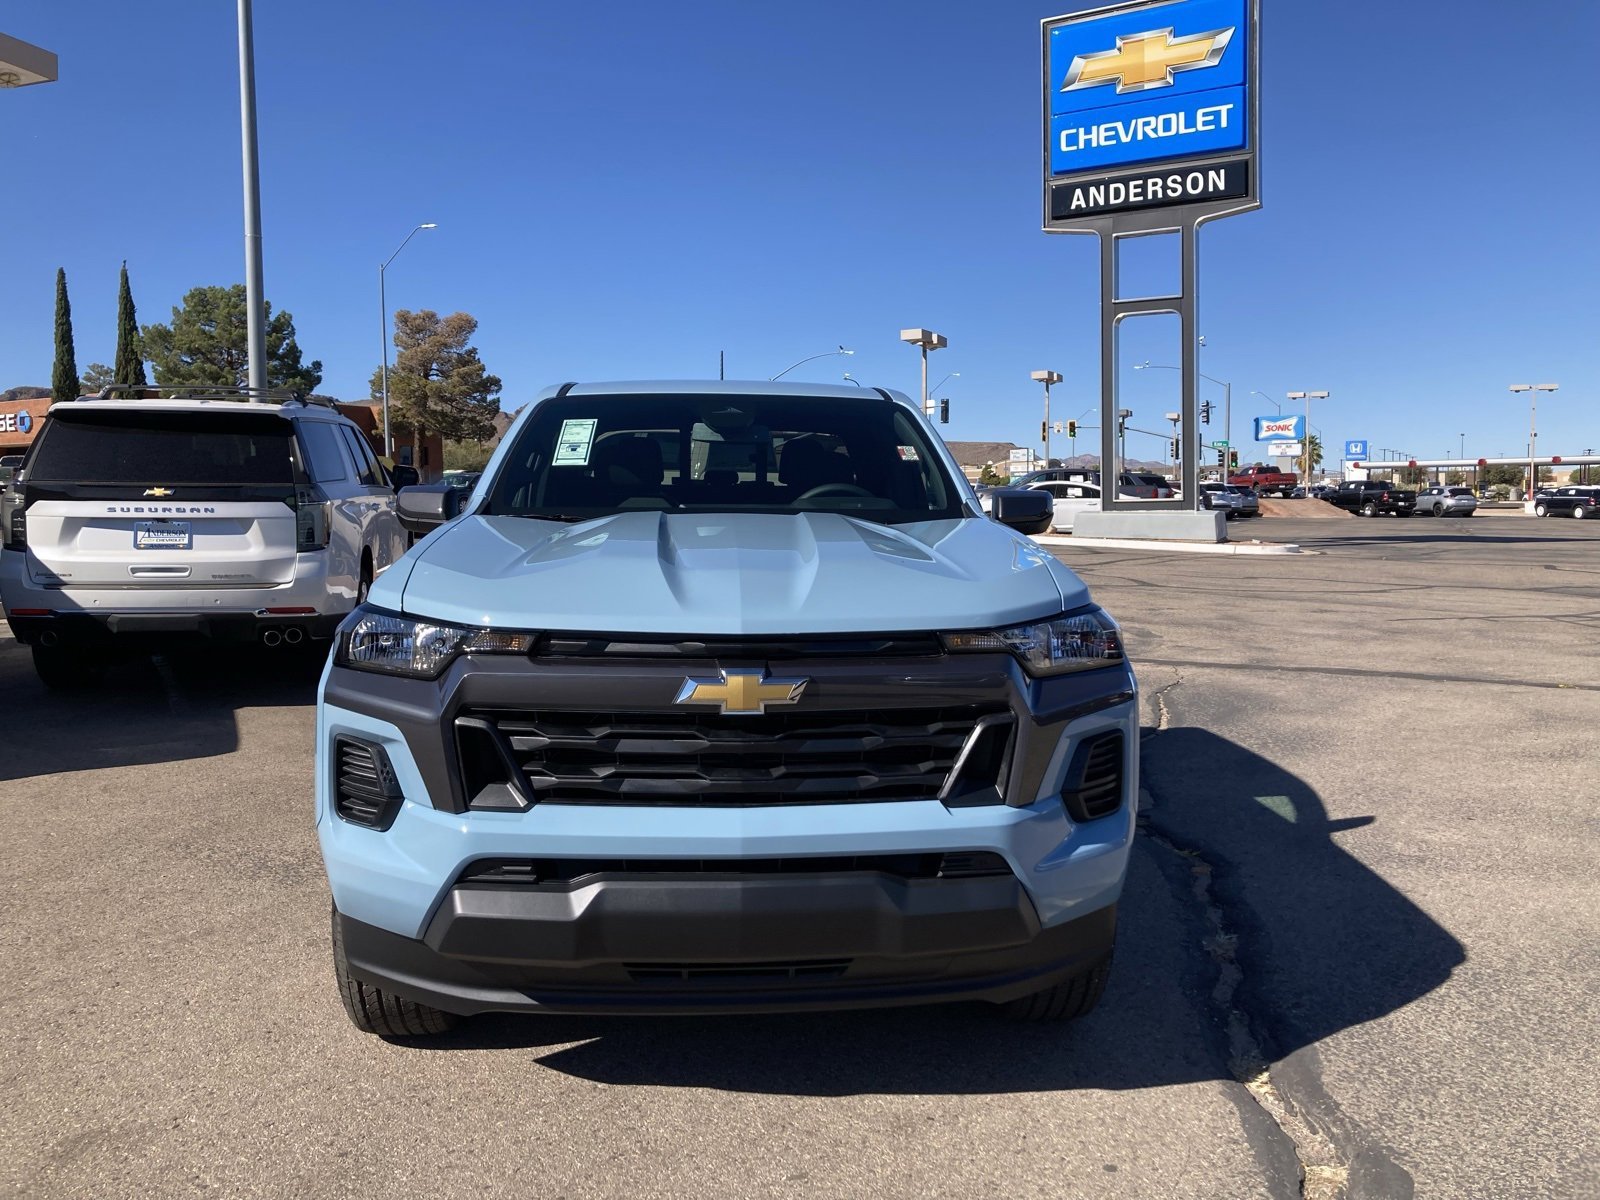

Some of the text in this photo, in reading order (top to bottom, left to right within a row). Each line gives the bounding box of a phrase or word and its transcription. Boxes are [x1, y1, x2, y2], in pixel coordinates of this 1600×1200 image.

[1060, 104, 1234, 152] CHEVROLET
[1071, 169, 1225, 210] ANDERSON
[1265, 424, 1293, 433] SONIC
[106, 506, 216, 514] SUBURBAN
